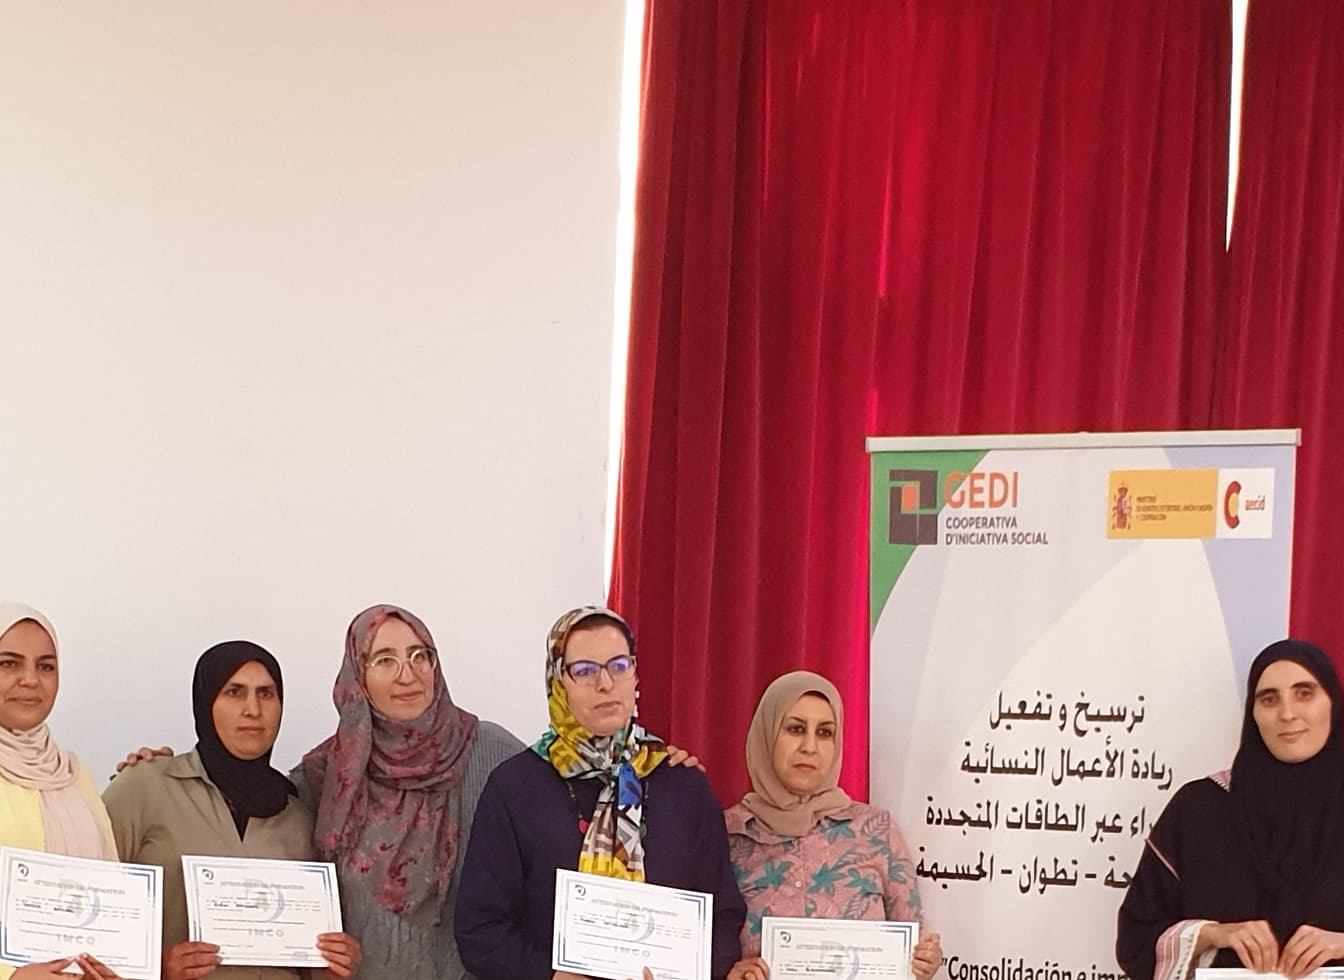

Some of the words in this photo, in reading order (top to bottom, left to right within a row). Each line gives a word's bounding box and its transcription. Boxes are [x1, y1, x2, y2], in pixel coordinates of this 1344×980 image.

[944, 470, 1019, 510] GEDI
[945, 516, 1018, 530] COOPERATIVA
[945, 532, 1009, 546] D'INICIATIVA
[1010, 531, 1049, 545] SOCIAL
[989, 690, 1053, 730] تفعيل
[1058, 703, 1068, 732] و
[1073, 691, 1145, 737] ترسيخ
[960, 741, 1046, 784] النسائية
[1051, 735, 1125, 786] الأعمال
[926, 795, 999, 836] المتجددة
[1005, 797, 1086, 832] الطاقات
[1090, 813, 1124, 843] عبر
[915, 845, 995, 889] الحسيمة
[1018, 856, 1078, 894] تطوان
